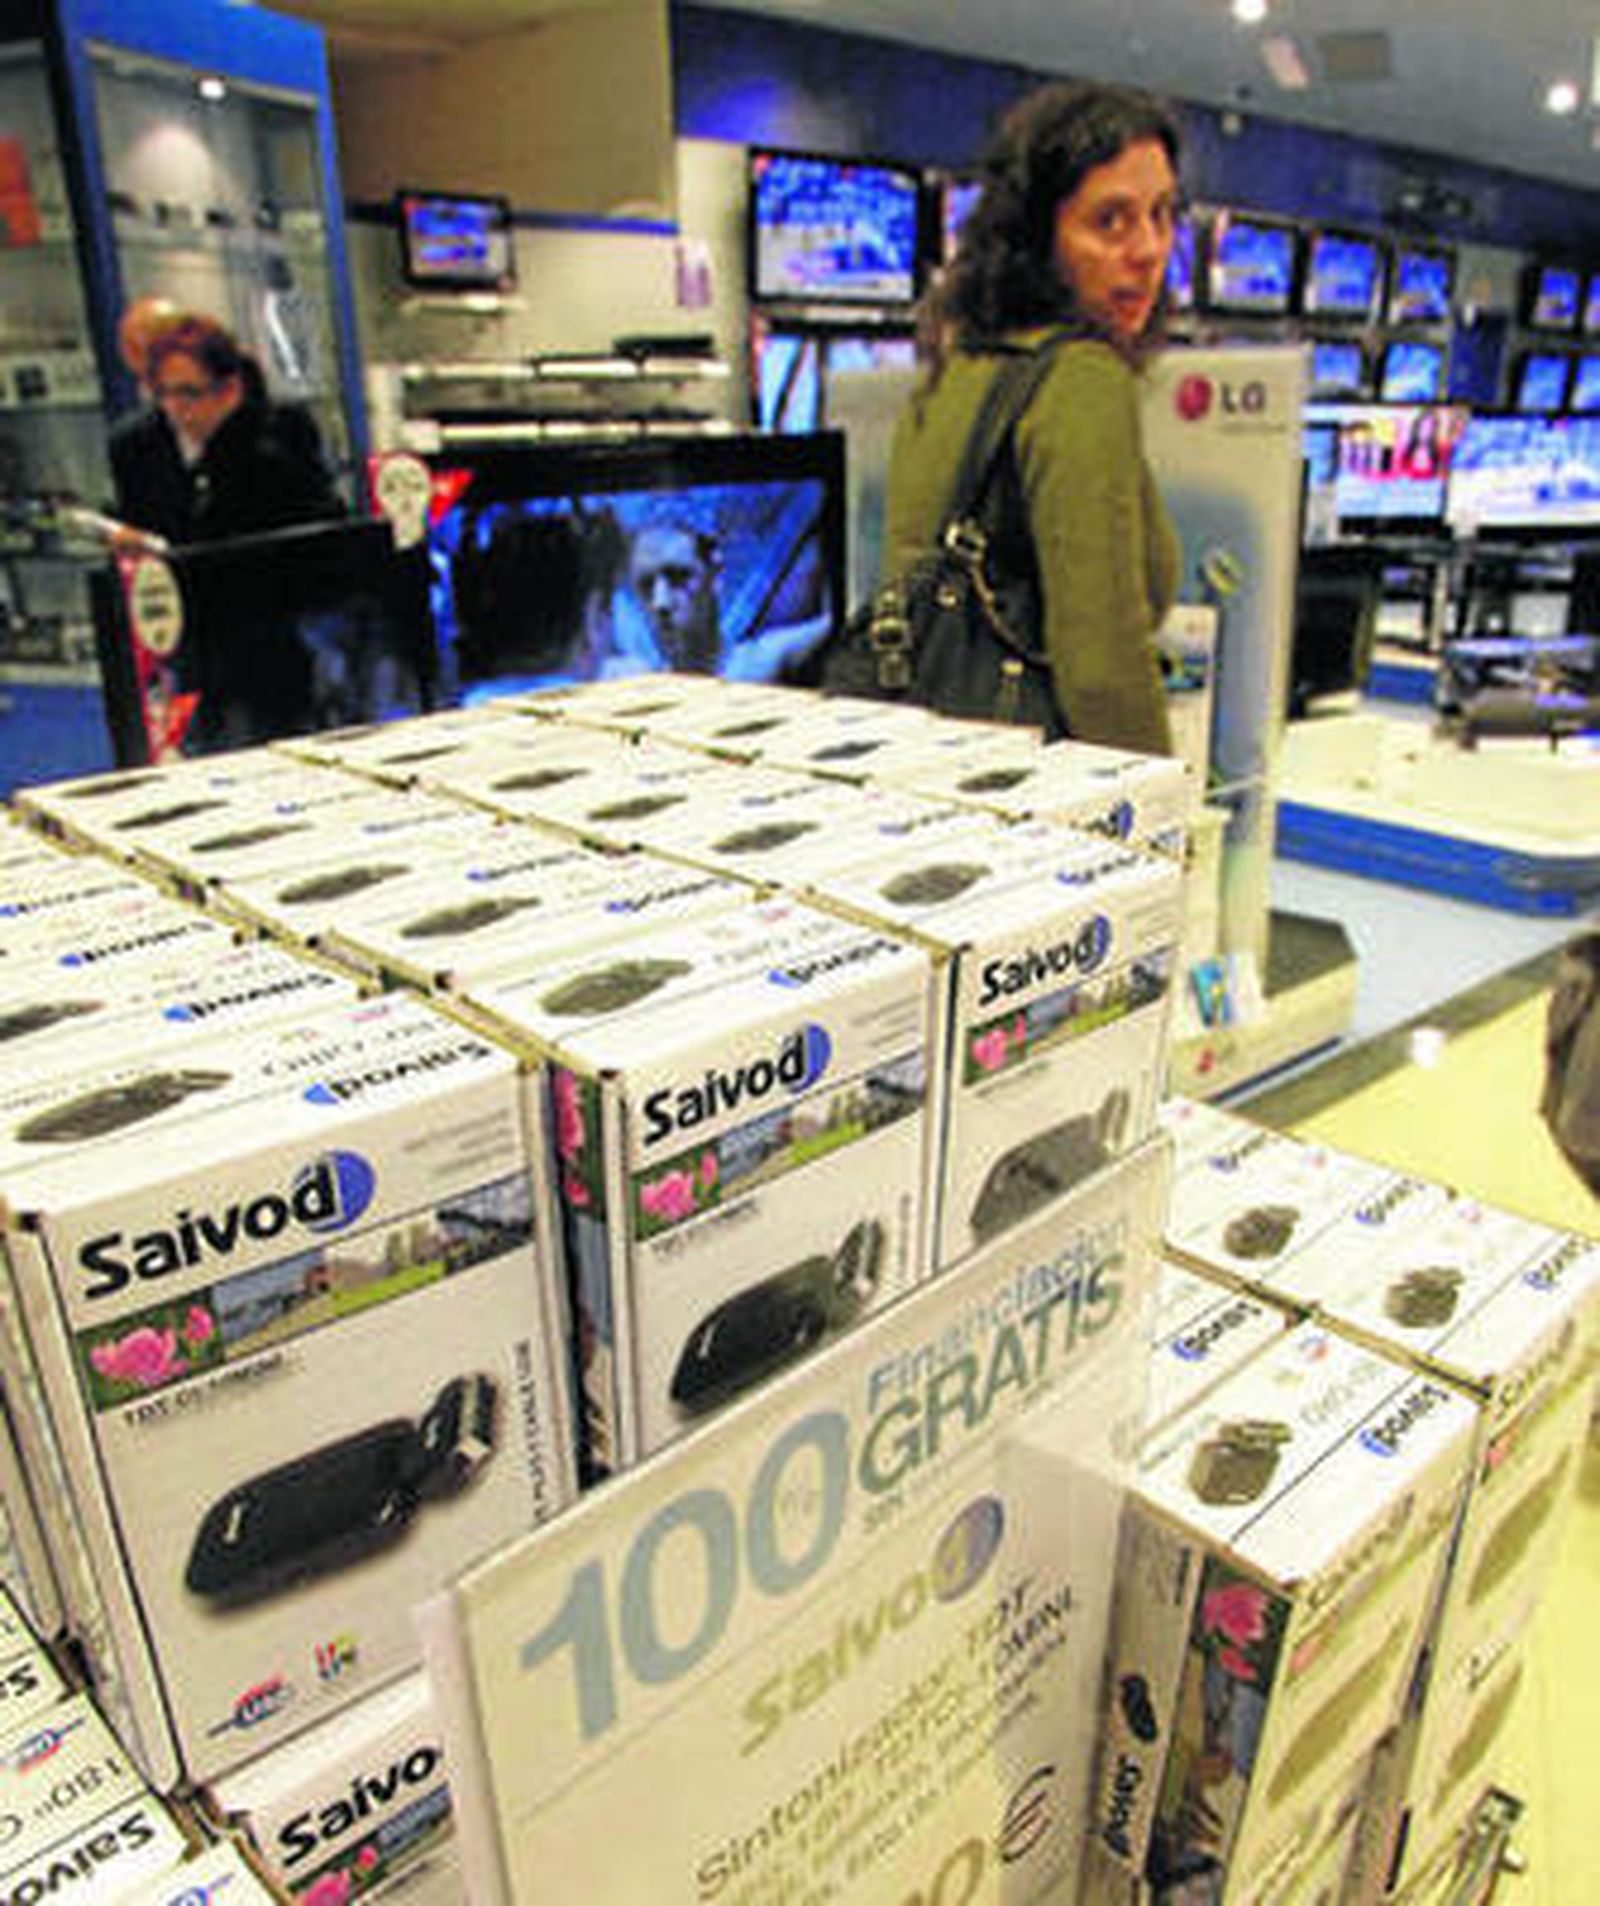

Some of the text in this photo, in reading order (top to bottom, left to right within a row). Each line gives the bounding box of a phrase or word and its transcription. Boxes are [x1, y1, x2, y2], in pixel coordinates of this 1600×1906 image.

[1220, 381, 1266, 416] LG
[978, 914, 1112, 1006] Saivod
[643, 1022, 832, 1145] Saivod
[77, 1149, 376, 1300] Saivod
[858, 1251, 1127, 1494] GRATIS
[518, 1410, 852, 1742] 100
[2, 1810, 155, 1906] Saivo
[278, 1746, 442, 1867] Saivo
